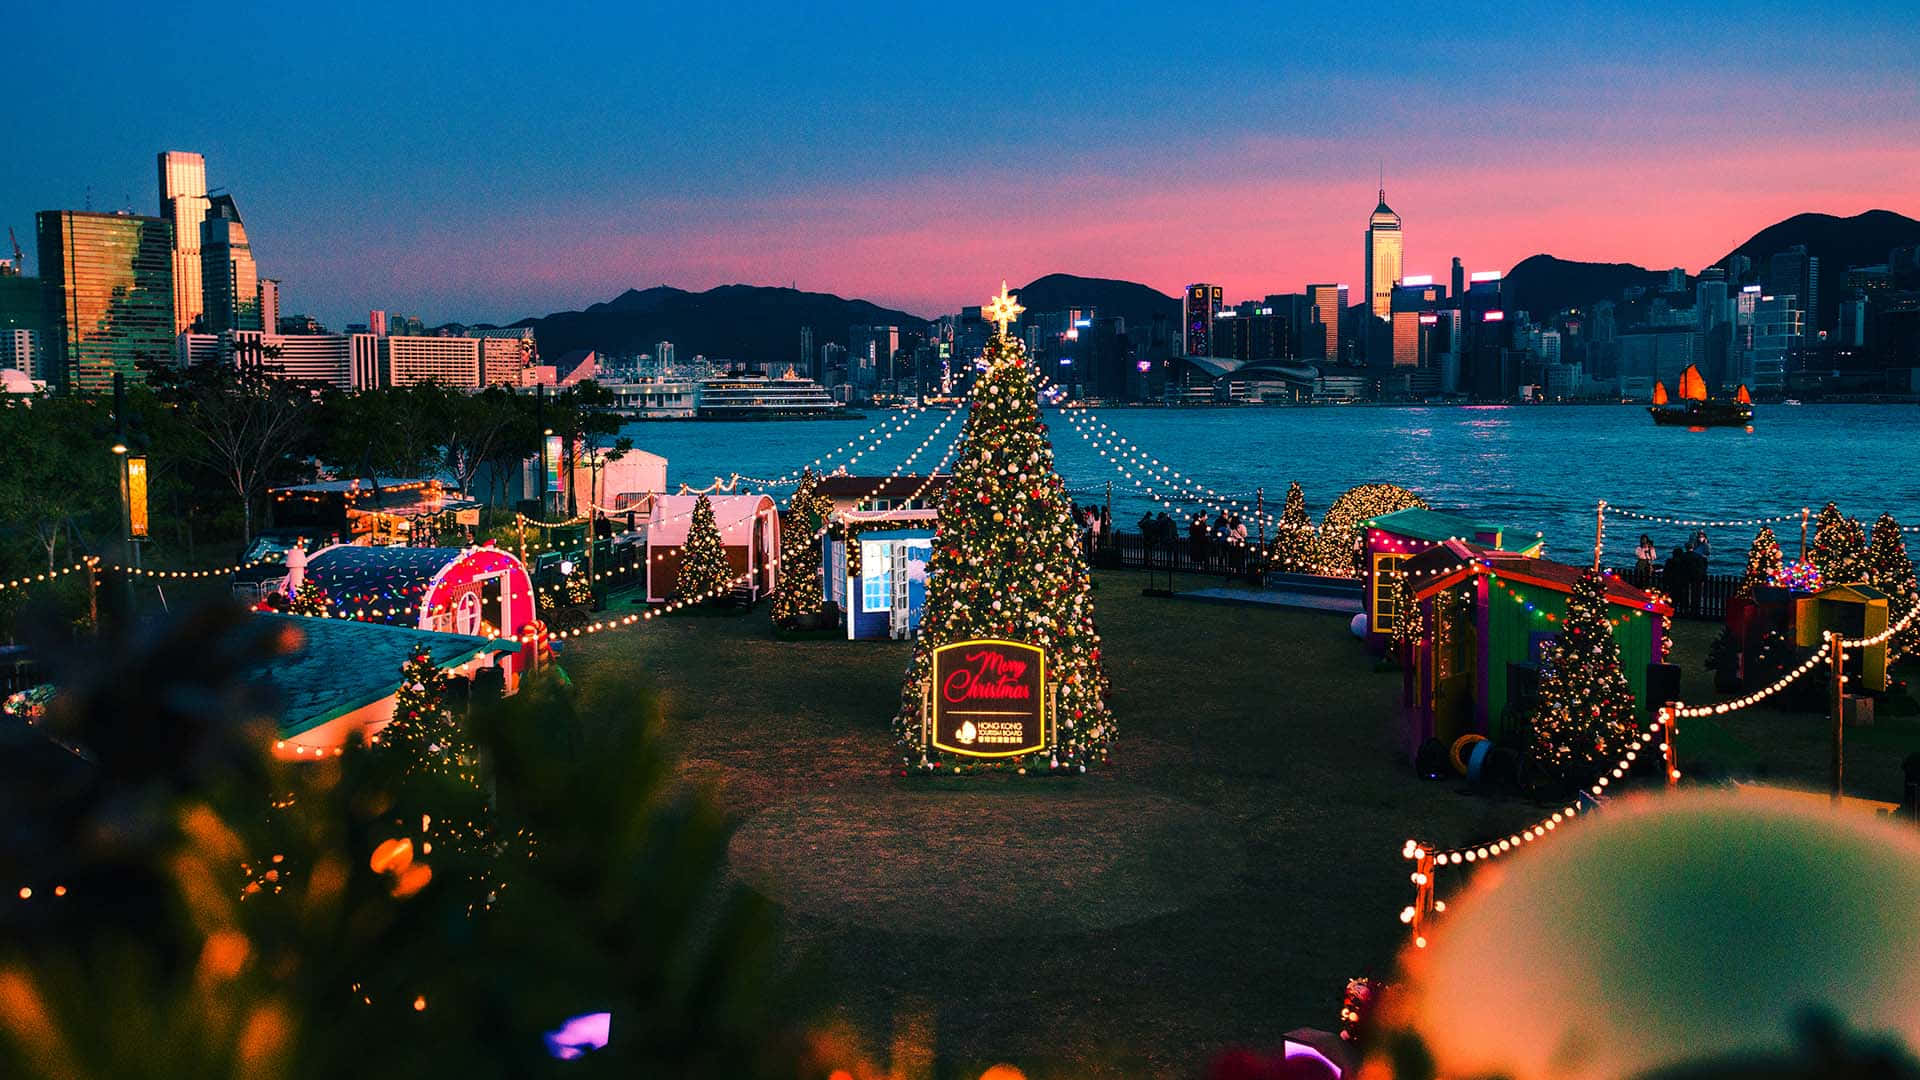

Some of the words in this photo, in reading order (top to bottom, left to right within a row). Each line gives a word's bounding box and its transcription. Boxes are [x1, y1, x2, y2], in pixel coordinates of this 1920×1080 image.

[965, 651, 1028, 678] Merry
[943, 669, 1030, 703] Christmas
[978, 721, 1000, 730] HONG
[1001, 722, 1023, 730] KONG
